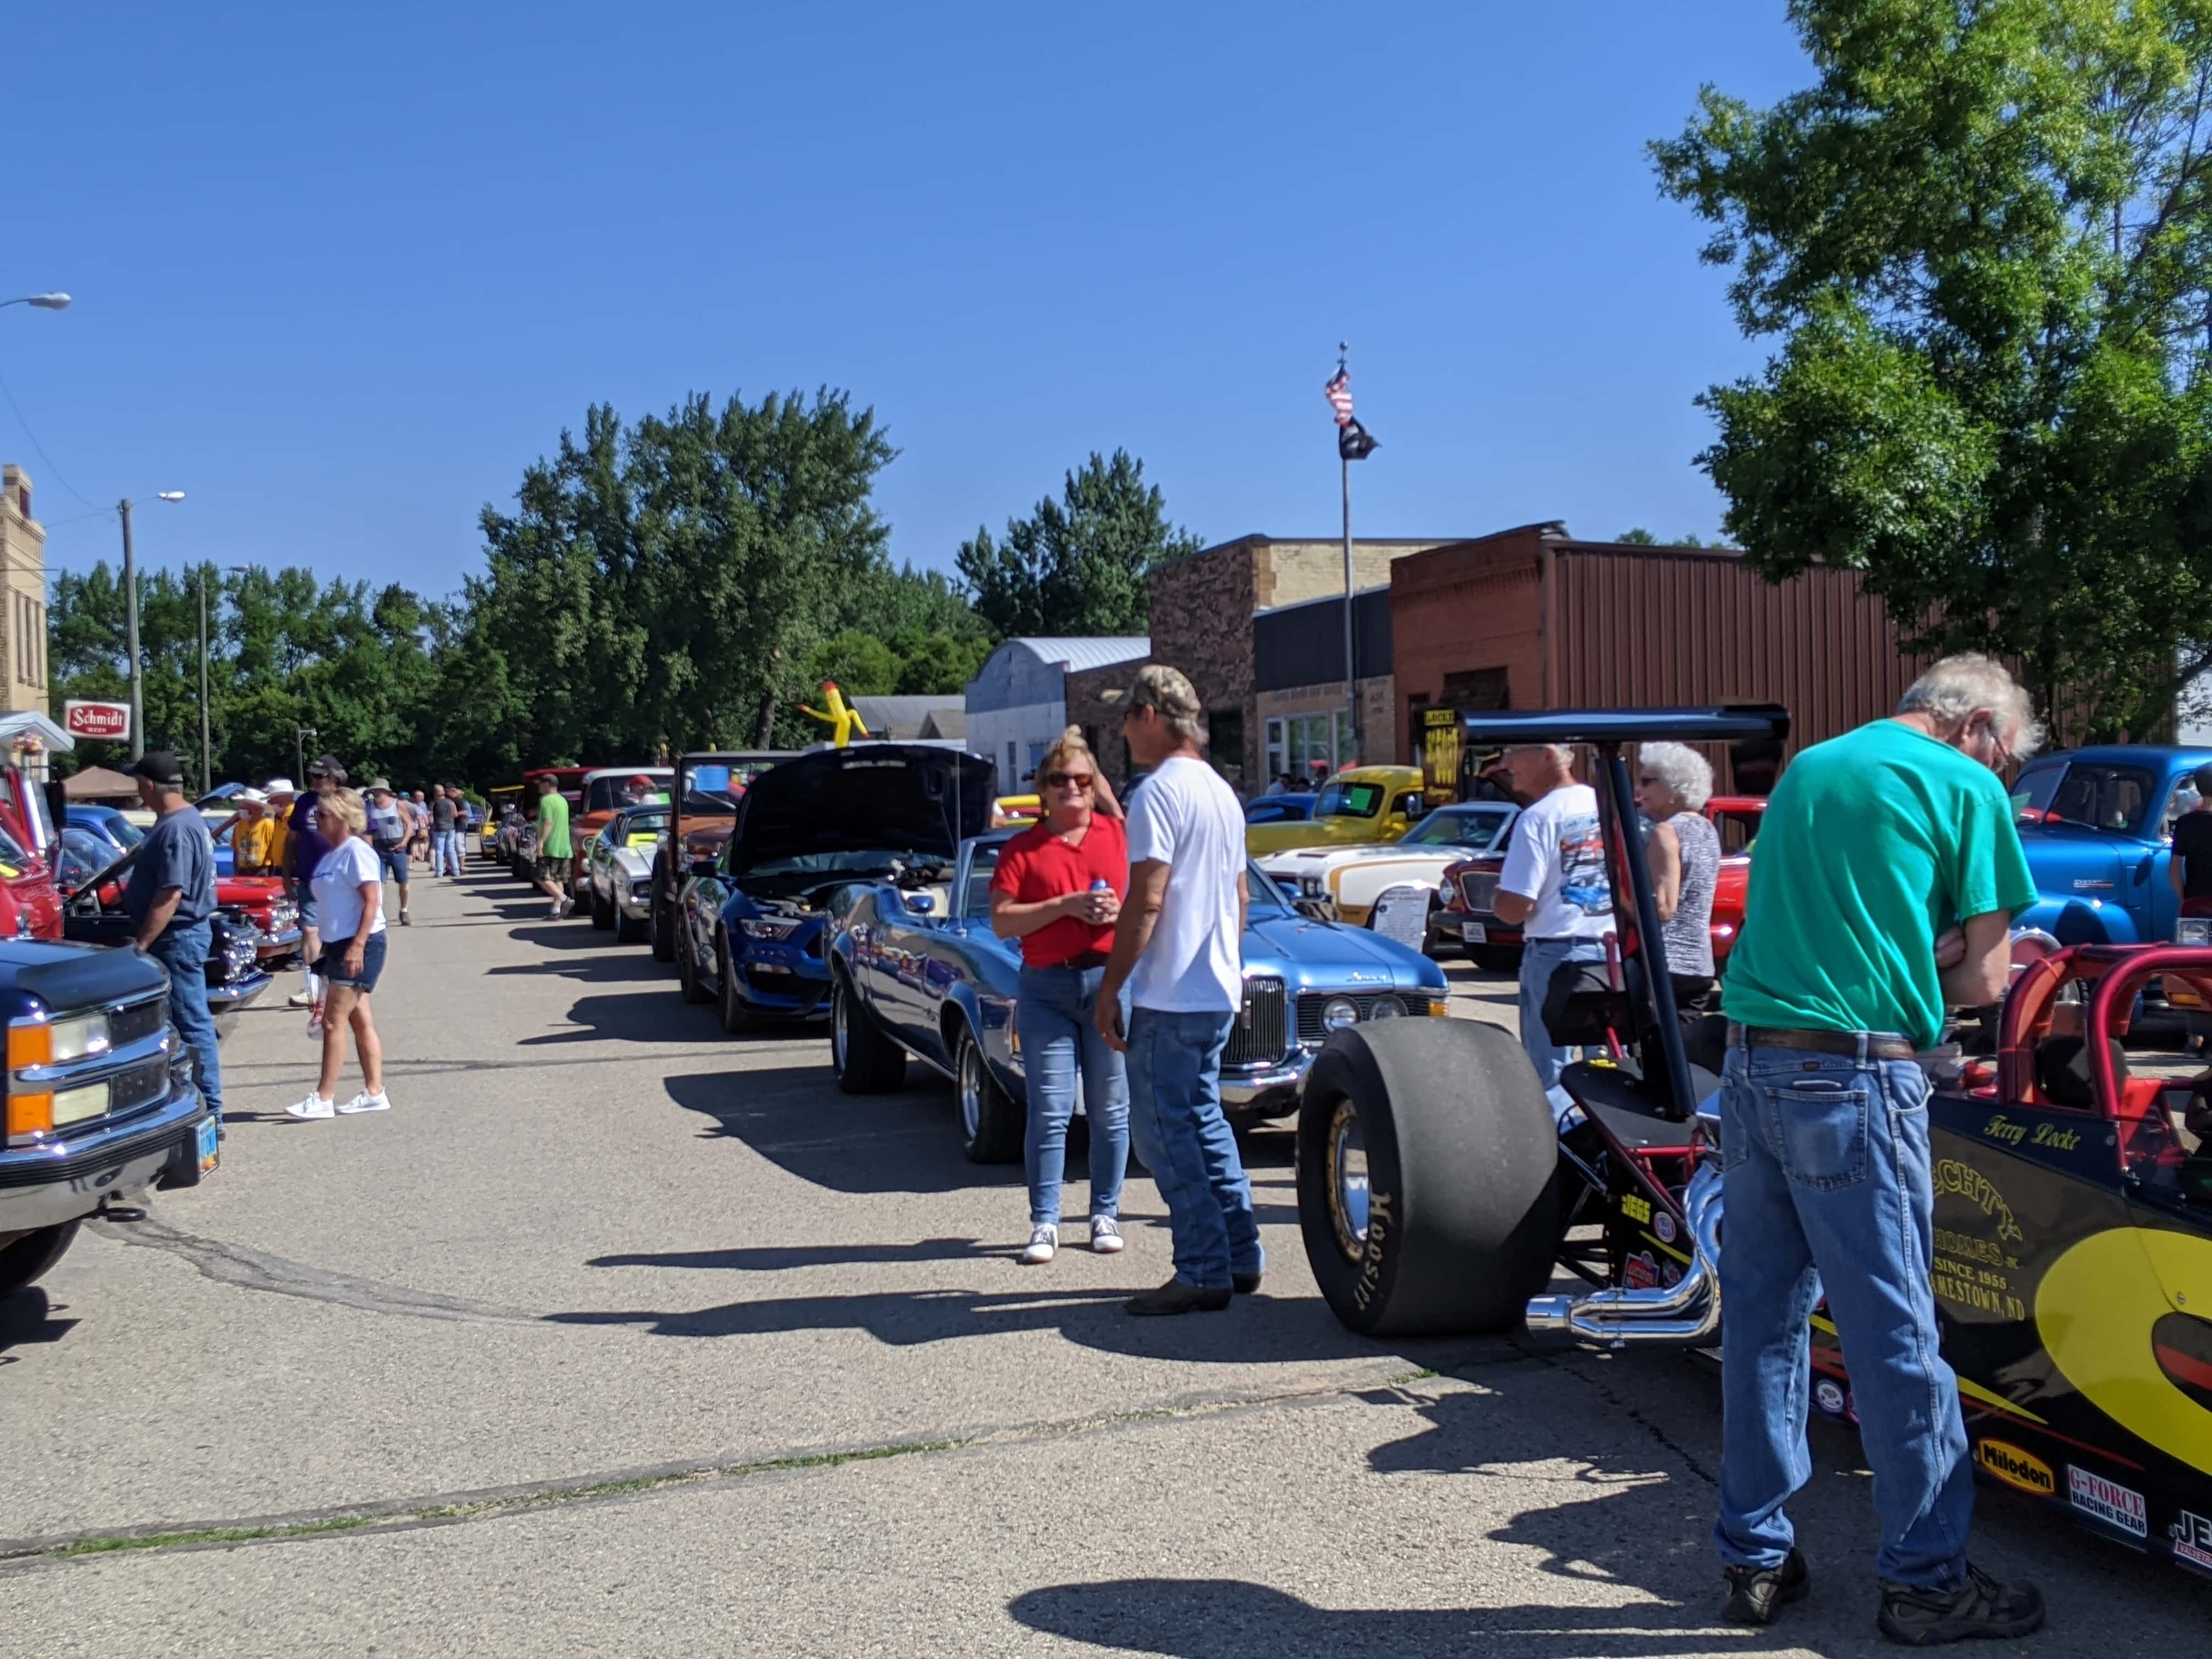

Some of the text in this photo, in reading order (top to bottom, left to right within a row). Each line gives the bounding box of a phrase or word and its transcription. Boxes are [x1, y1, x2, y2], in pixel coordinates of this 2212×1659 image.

[72, 708, 123, 726] Schmidt
[1983, 1115, 2081, 1150] Terry Locke
[1621, 1193, 1650, 1224] JEGS
[1353, 1191, 1394, 1311] Hoosier
[1934, 1256, 2007, 1290] SINCE 1955
[1983, 1443, 2051, 1489] Milodon
[2070, 1469, 2143, 1519] G-FORCE
[2072, 1490, 2145, 1534] RACING GEAR
